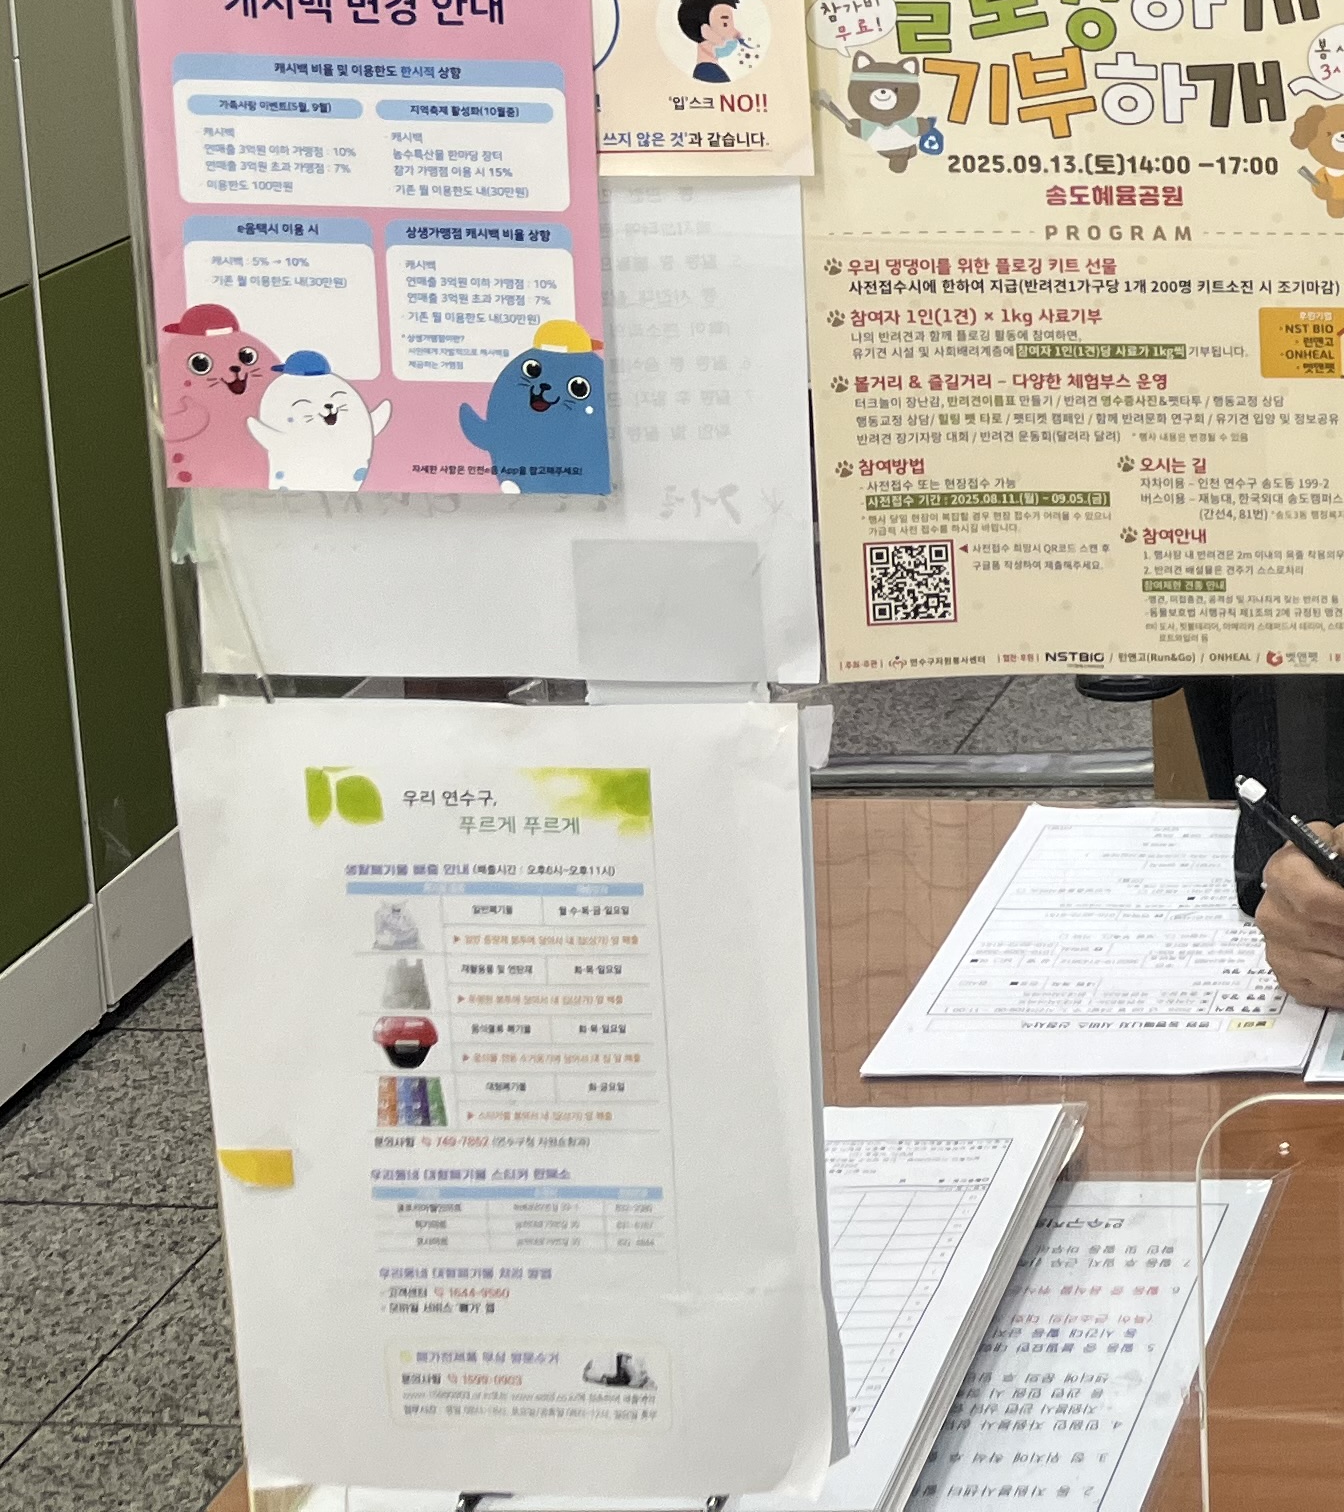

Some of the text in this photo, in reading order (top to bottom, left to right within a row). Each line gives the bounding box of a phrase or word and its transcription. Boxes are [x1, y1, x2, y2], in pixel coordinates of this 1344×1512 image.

[835, 17, 882, 41] 무료!
[275, 62, 461, 79] 캐시백 비율 및 이용한도 한시적 상향
[410, 105, 448, 116] 지역축제
[720, 94, 768, 112] NO!!
[603, 133, 631, 147] 쓰지
[637, 132, 665, 146] 않은
[708, 132, 769, 147] 같습니다.
[947, 154, 1191, 176] 2025.09.13.(토)14:00
[1045, 185, 1184, 208] 송도혜윰공원
[282, 223, 304, 236] 이용
[308, 224, 319, 235] 시
[406, 227, 550, 242] 상생가맹점 캐시백 비율 상향
[1045, 225, 1193, 243] PROGRAM
[849, 257, 1117, 276] 우리 댕댕이를 위한 플로깅 키트 선물
[849, 277, 1340, 296] 사전접수시에 한하여 지급(반려견1가구당 1개 200명 키트소진 시 조기마감)
[850, 308, 1103, 327] 참여자 1인(1견) 1kg 사료기부
[1285, 324, 1333, 334] NST BIO
[1286, 350, 1334, 360] ONHEAL
[854, 373, 1167, 392] 볼거리 즐길거리 다양한 체험부스 운영
[859, 458, 925, 476] 참여방법
[1140, 457, 1207, 474] 오시는 길
[1198, 478, 1220, 489] 인천
[1224, 478, 1257, 488] 연수구
[1299, 478, 1329, 488] 199-2
[868, 495, 915, 507] 사전접수
[918, 494, 940, 506] 기간
[1142, 528, 1207, 544] 참여안내
[1045, 652, 1251, 662] NSTBIO ONHEAL
[402, 790, 497, 807] 우리 연수구,
[459, 816, 580, 835] 푸르게 푸르게
